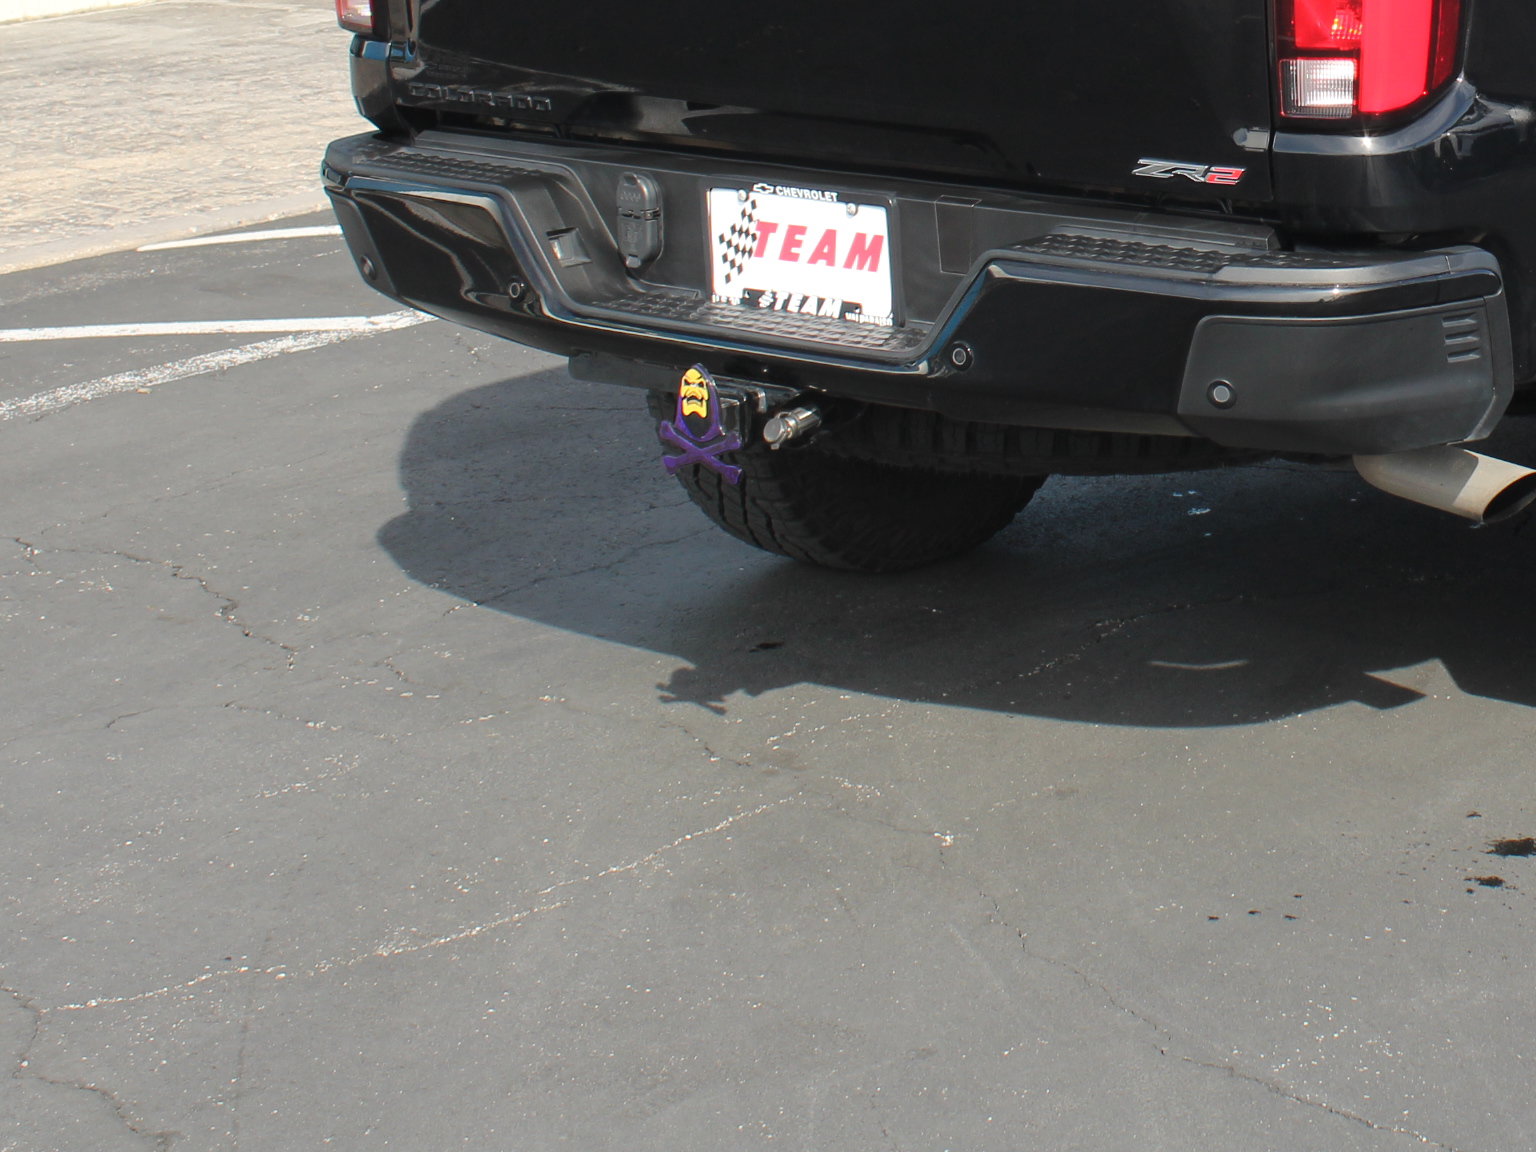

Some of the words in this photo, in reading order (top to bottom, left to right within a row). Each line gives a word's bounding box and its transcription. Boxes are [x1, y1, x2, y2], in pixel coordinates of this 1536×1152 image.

[1131, 157, 1247, 186] ZR2
[775, 185, 838, 202] CHEVROLET
[753, 220, 885, 273] TEAM
[773, 291, 843, 319] TEAM
